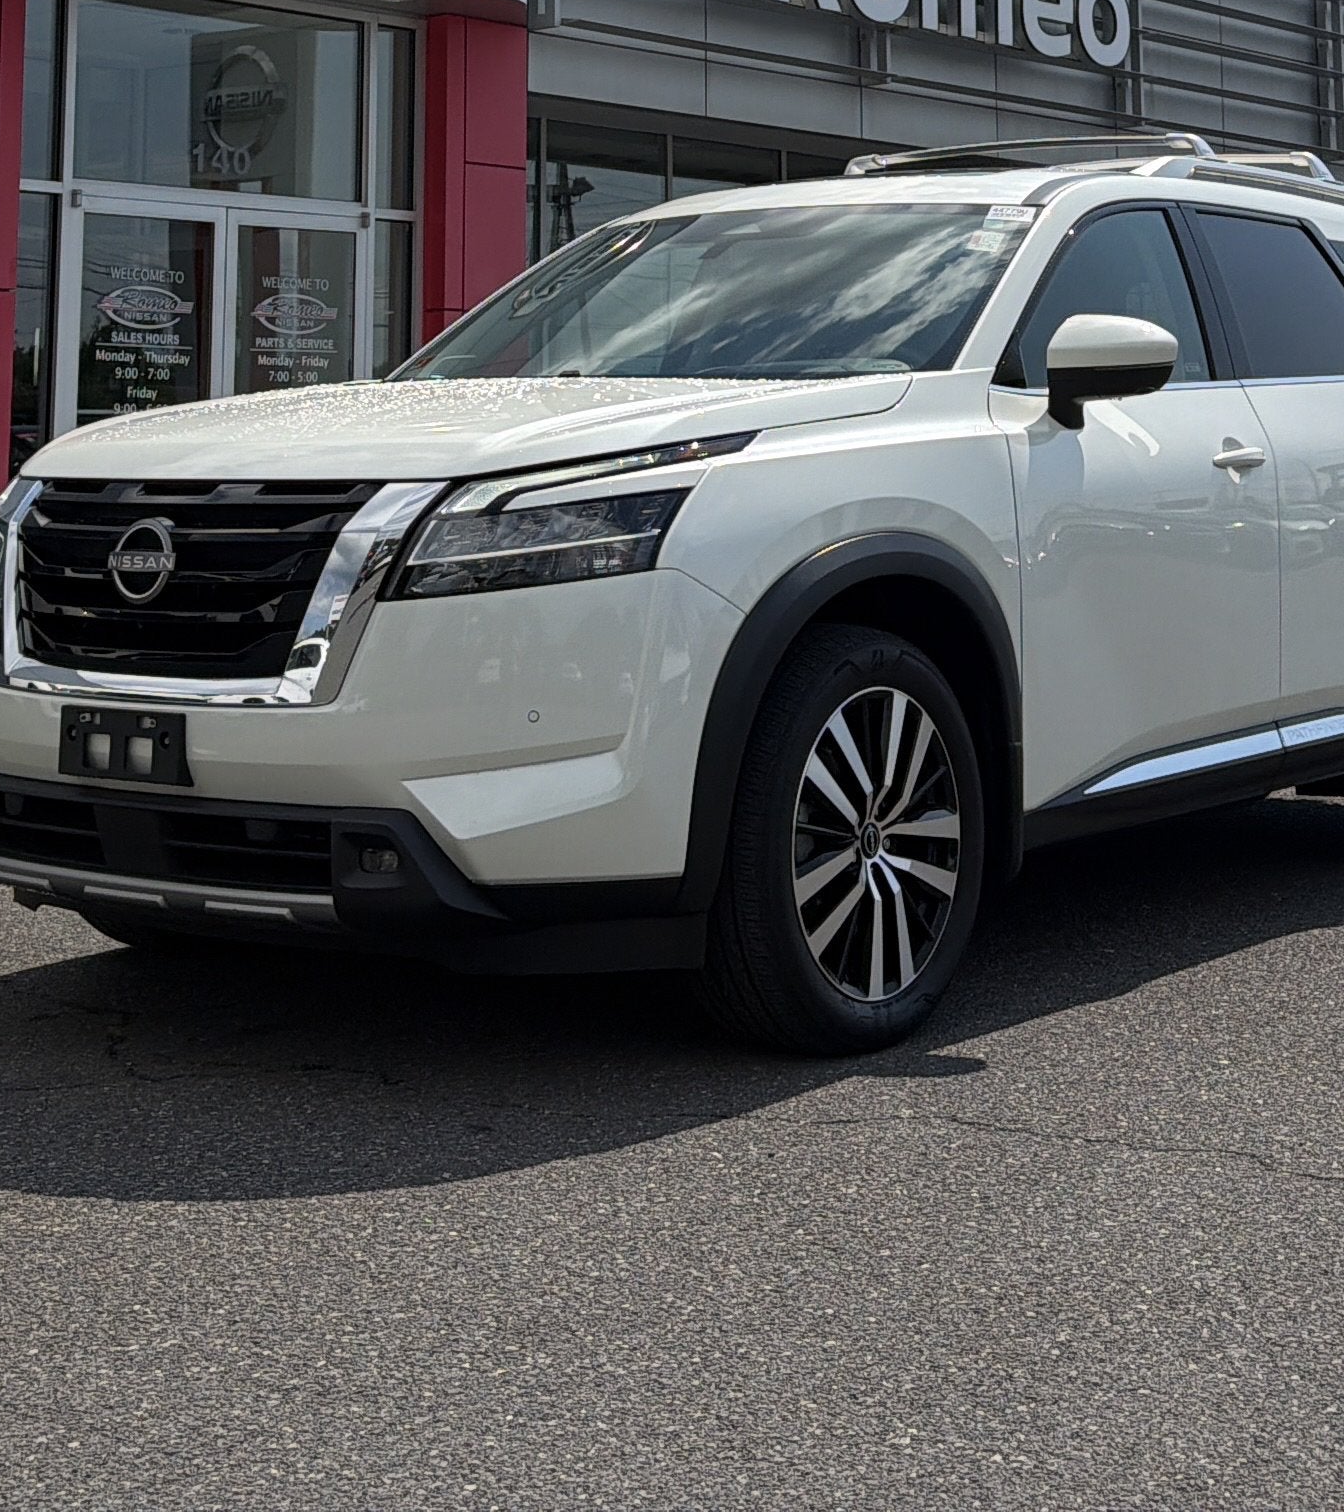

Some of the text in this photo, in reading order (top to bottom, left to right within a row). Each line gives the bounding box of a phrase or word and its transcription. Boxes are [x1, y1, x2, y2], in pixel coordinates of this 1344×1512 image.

[193, 143, 251, 175] 140
[110, 266, 185, 284] WELCOME TO
[262, 276, 329, 291] WELCOME TO
[120, 289, 180, 311] Romeo
[272, 297, 324, 316] Romeo
[124, 311, 167, 321] NISSAN
[275, 318, 314, 327] NISSAN
[111, 331, 180, 345] SALES HOURS
[256, 337, 334, 349] PARTS & SERVICE
[95, 349, 136, 363] Monday
[144, 351, 190, 366] Thursday
[258, 354, 294, 368] Monday
[302, 356, 329, 368] Friday
[115, 367, 138, 379] 9:00
[148, 369, 170, 380] 7:00
[269, 371, 289, 382] 7:00
[297, 372, 318, 382] 5:00
[127, 386, 158, 401] Friday
[113, 403, 137, 414] 9:00
[108, 555, 173, 569] NISSAN
